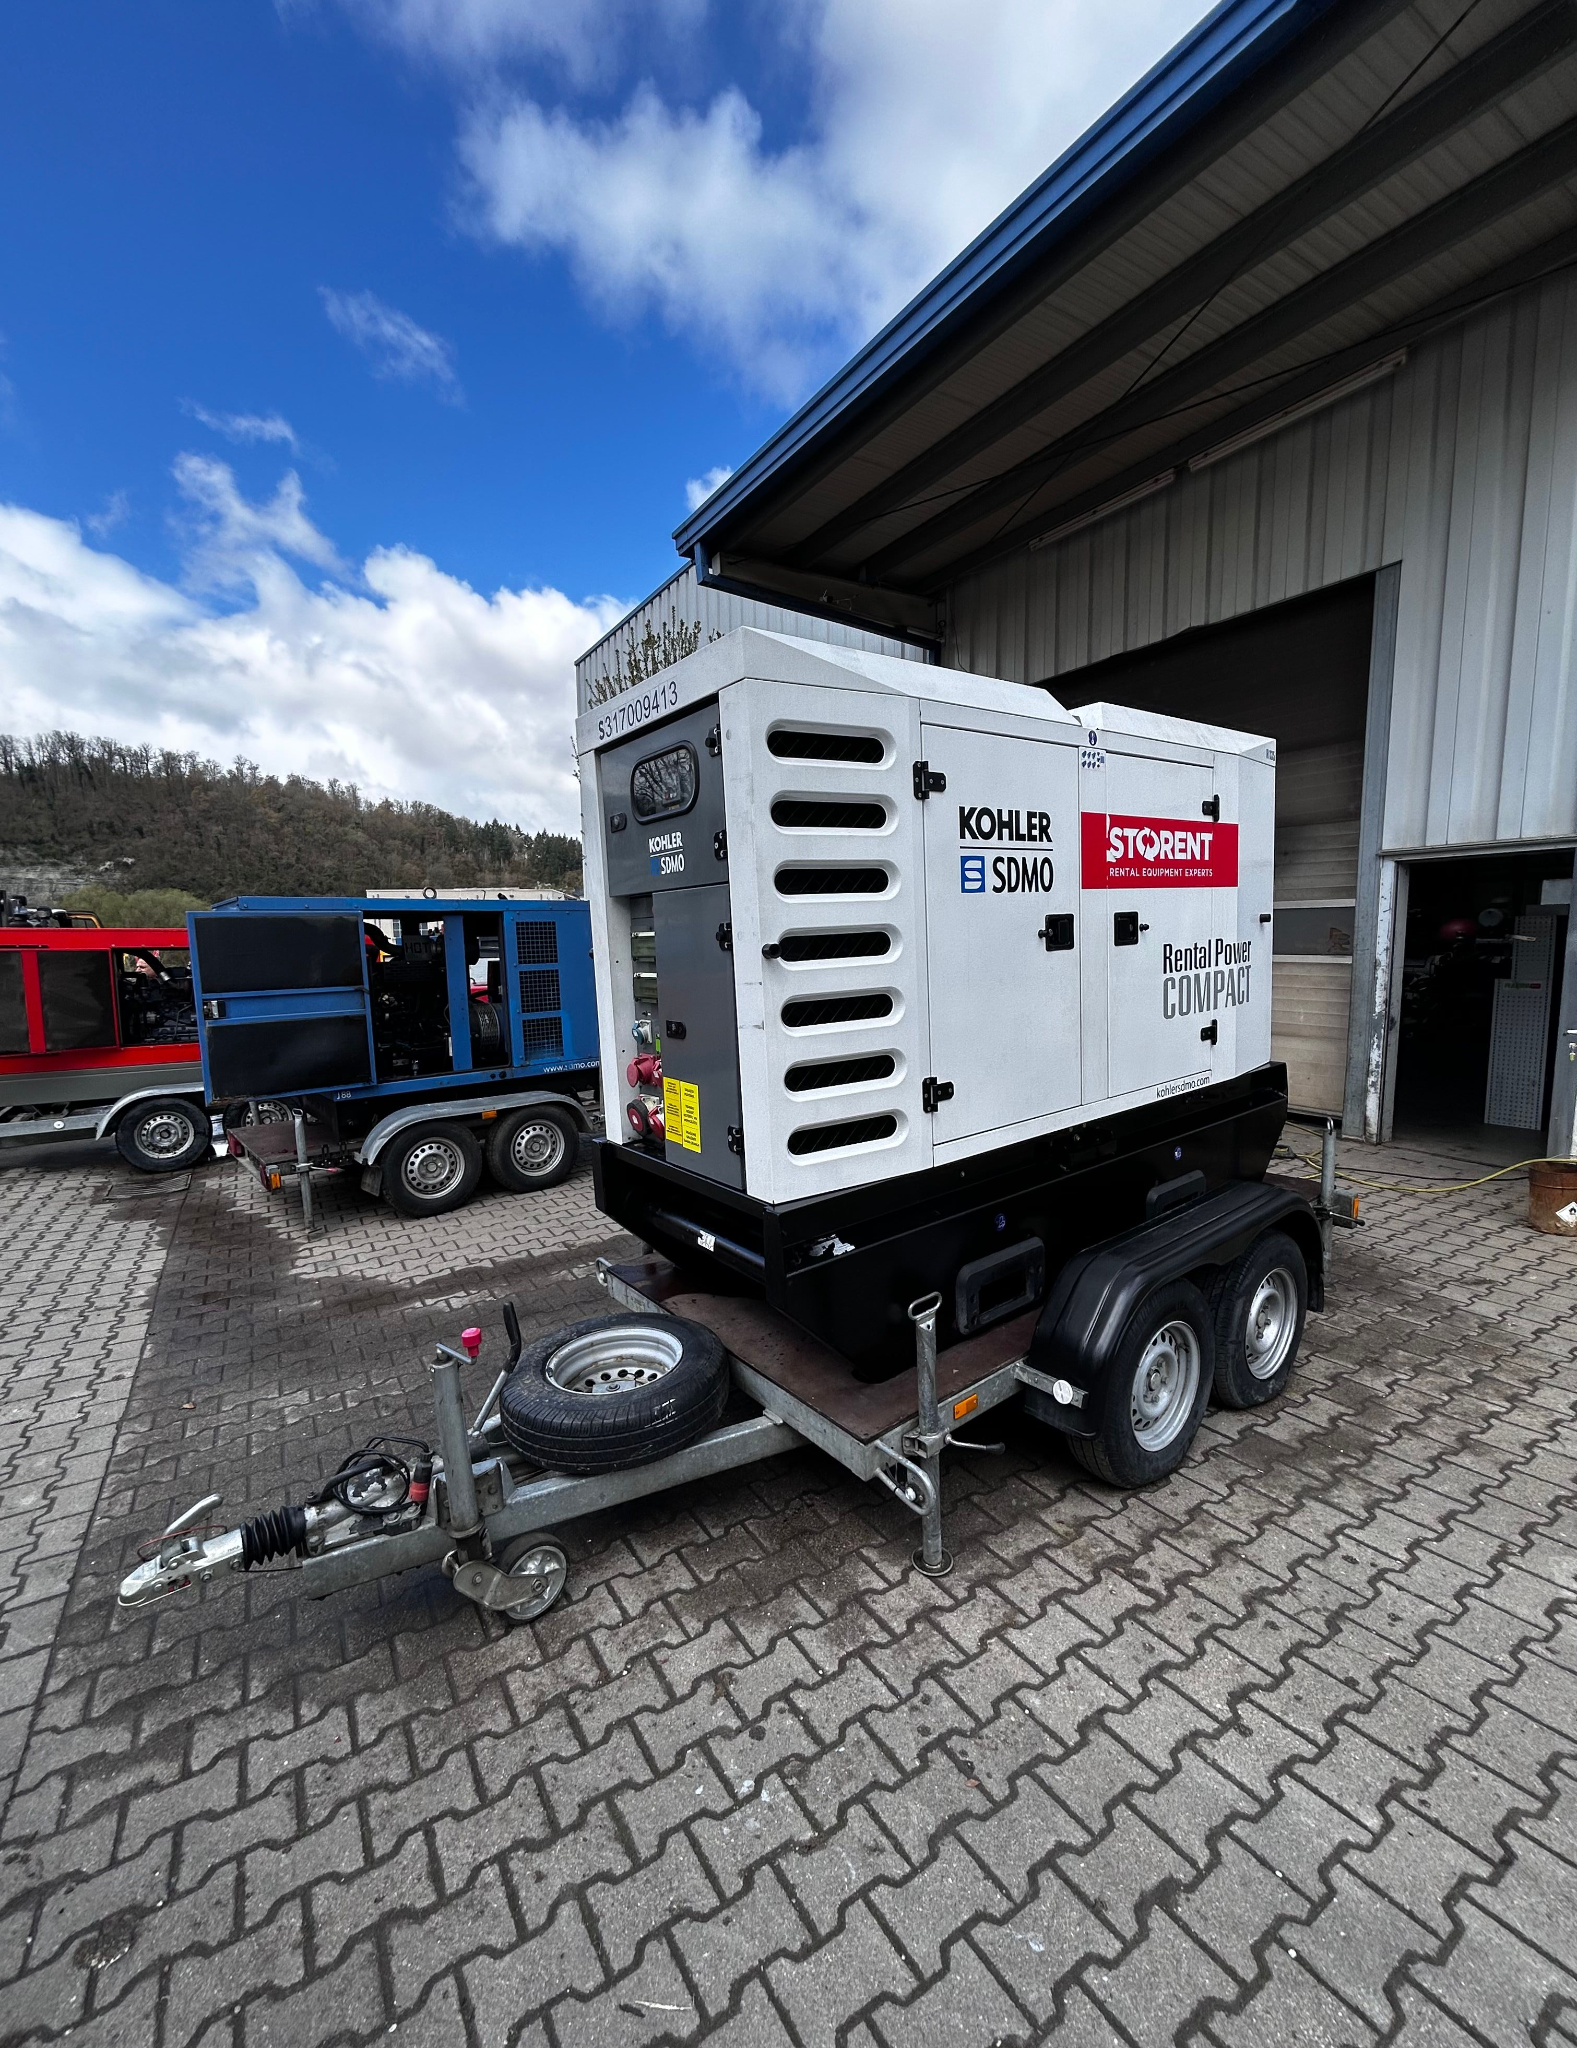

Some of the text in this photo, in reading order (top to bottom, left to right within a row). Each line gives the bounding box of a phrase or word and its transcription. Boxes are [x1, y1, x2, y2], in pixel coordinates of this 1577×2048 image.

[598, 681, 678, 740] S317009413
[959, 806, 1053, 842] KOHLER
[649, 832, 683, 853] KOHLER
[1109, 826, 1213, 861] STORENT
[661, 854, 685, 874] SDMO
[992, 856, 1053, 893] SDMO
[1110, 868, 1213, 877] RENTAL EQUIPMENT EXPERTS
[1163, 938, 1251, 974] Rental Power
[1163, 965, 1251, 1019] COMPACT
[1157, 1077, 1210, 1098] kohlersdmo.com
